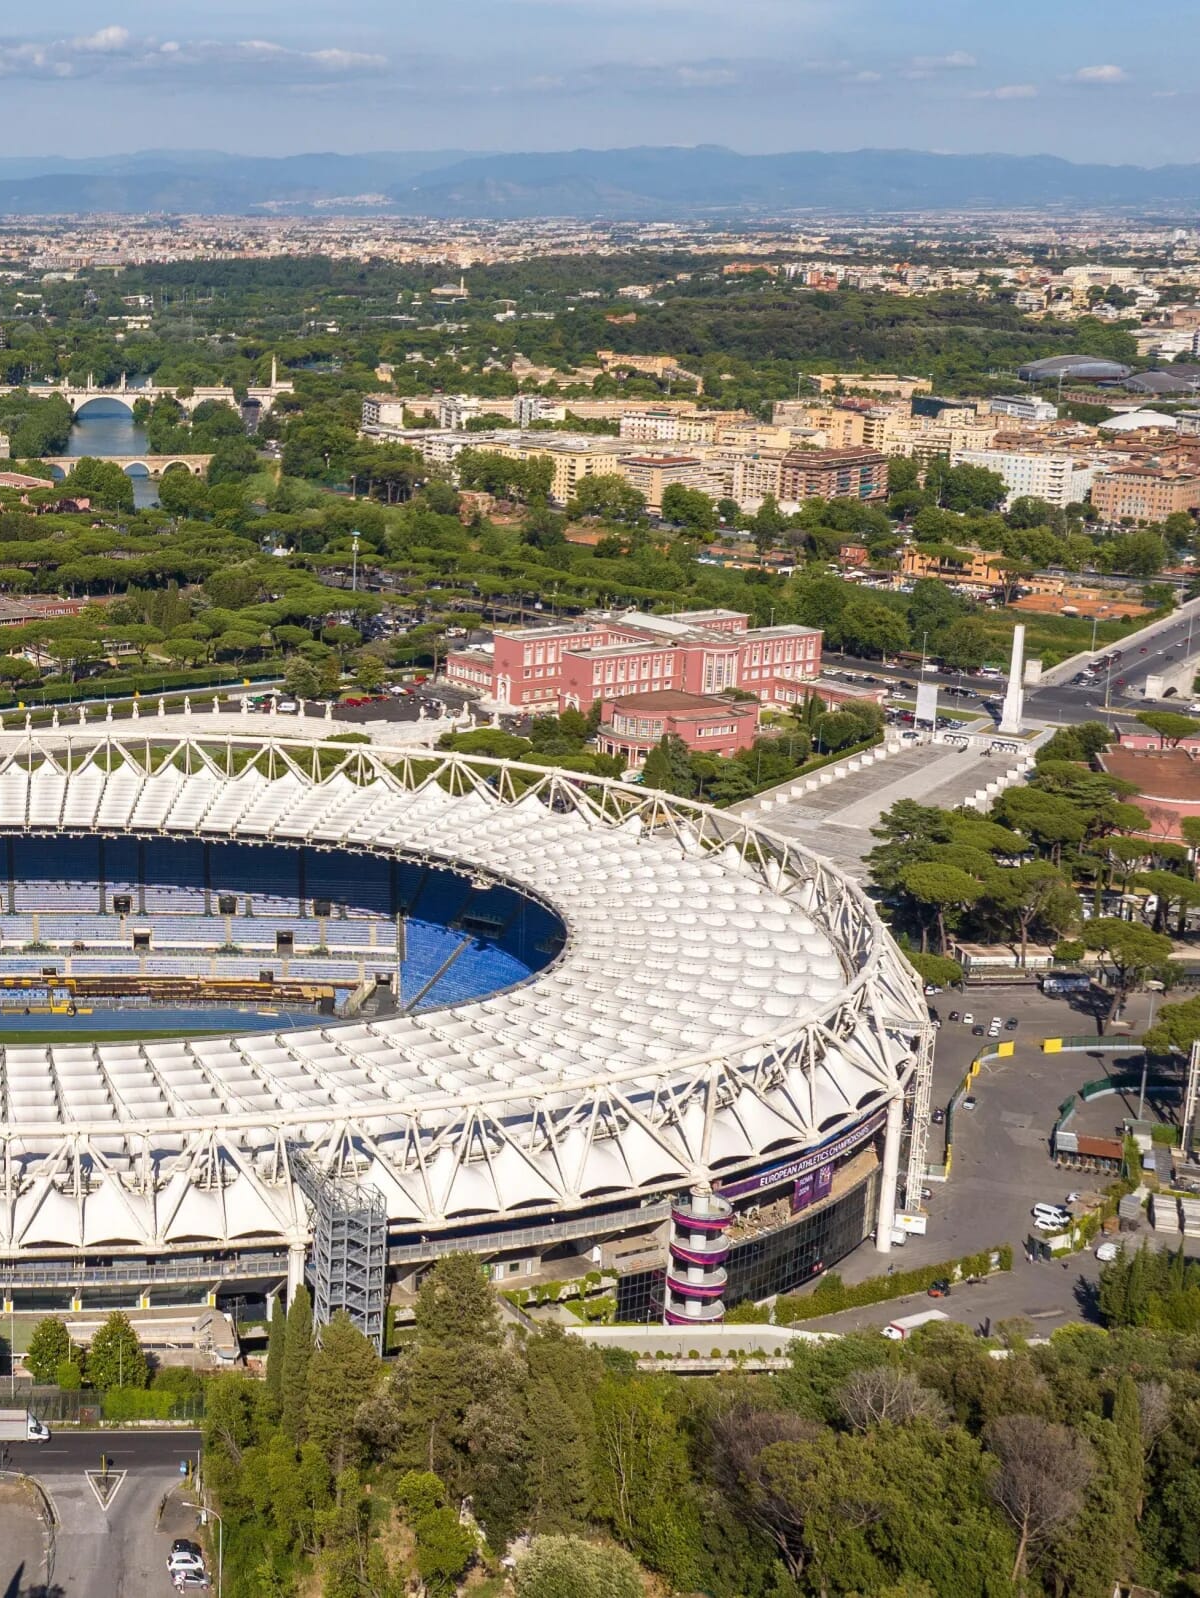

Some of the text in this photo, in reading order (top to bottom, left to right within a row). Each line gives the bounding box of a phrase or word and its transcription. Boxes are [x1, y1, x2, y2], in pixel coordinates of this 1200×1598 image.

[760, 1165, 798, 1186] EUROPEAN
[798, 1151, 829, 1171] ATHLETICS
[829, 1126, 869, 1156] CHAMPIONSHIPS
